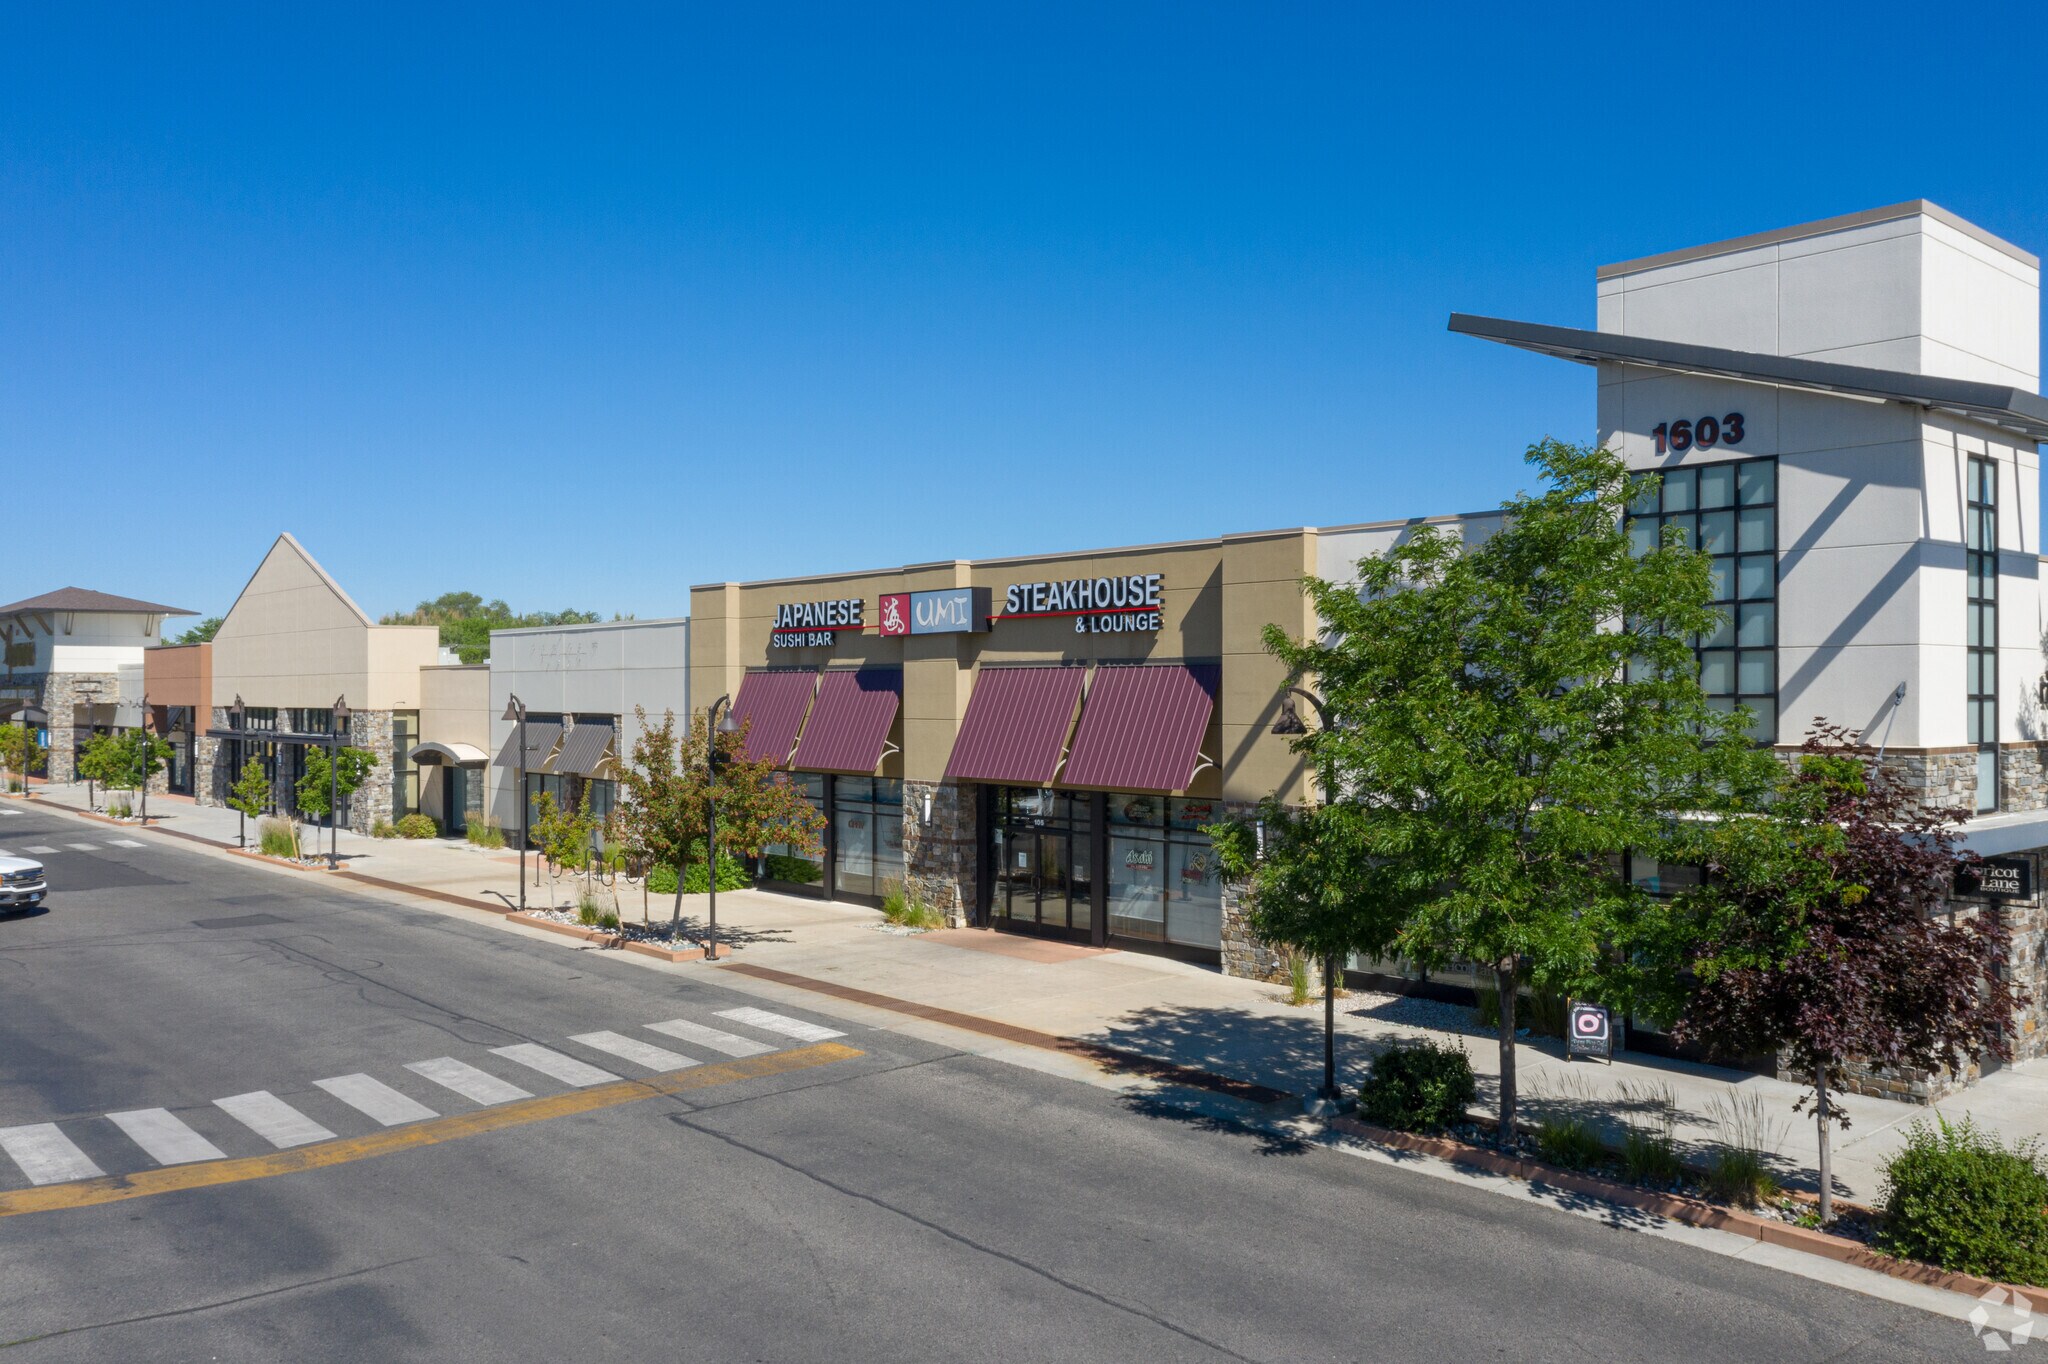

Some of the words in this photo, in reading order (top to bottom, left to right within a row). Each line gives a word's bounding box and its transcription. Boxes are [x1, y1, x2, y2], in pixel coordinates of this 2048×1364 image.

[1652, 412, 1745, 454] 1603
[1006, 573, 1161, 613] STEAKHOUSE
[773, 599, 860, 628] JAPANESE
[916, 597, 968, 627] UMI
[1075, 616, 1085, 633] &
[1091, 613, 1159, 633] LOUNGE
[773, 632, 805, 648] SUSHI
[808, 632, 832, 647] BAR
[1981, 876, 2020, 889] Lane
